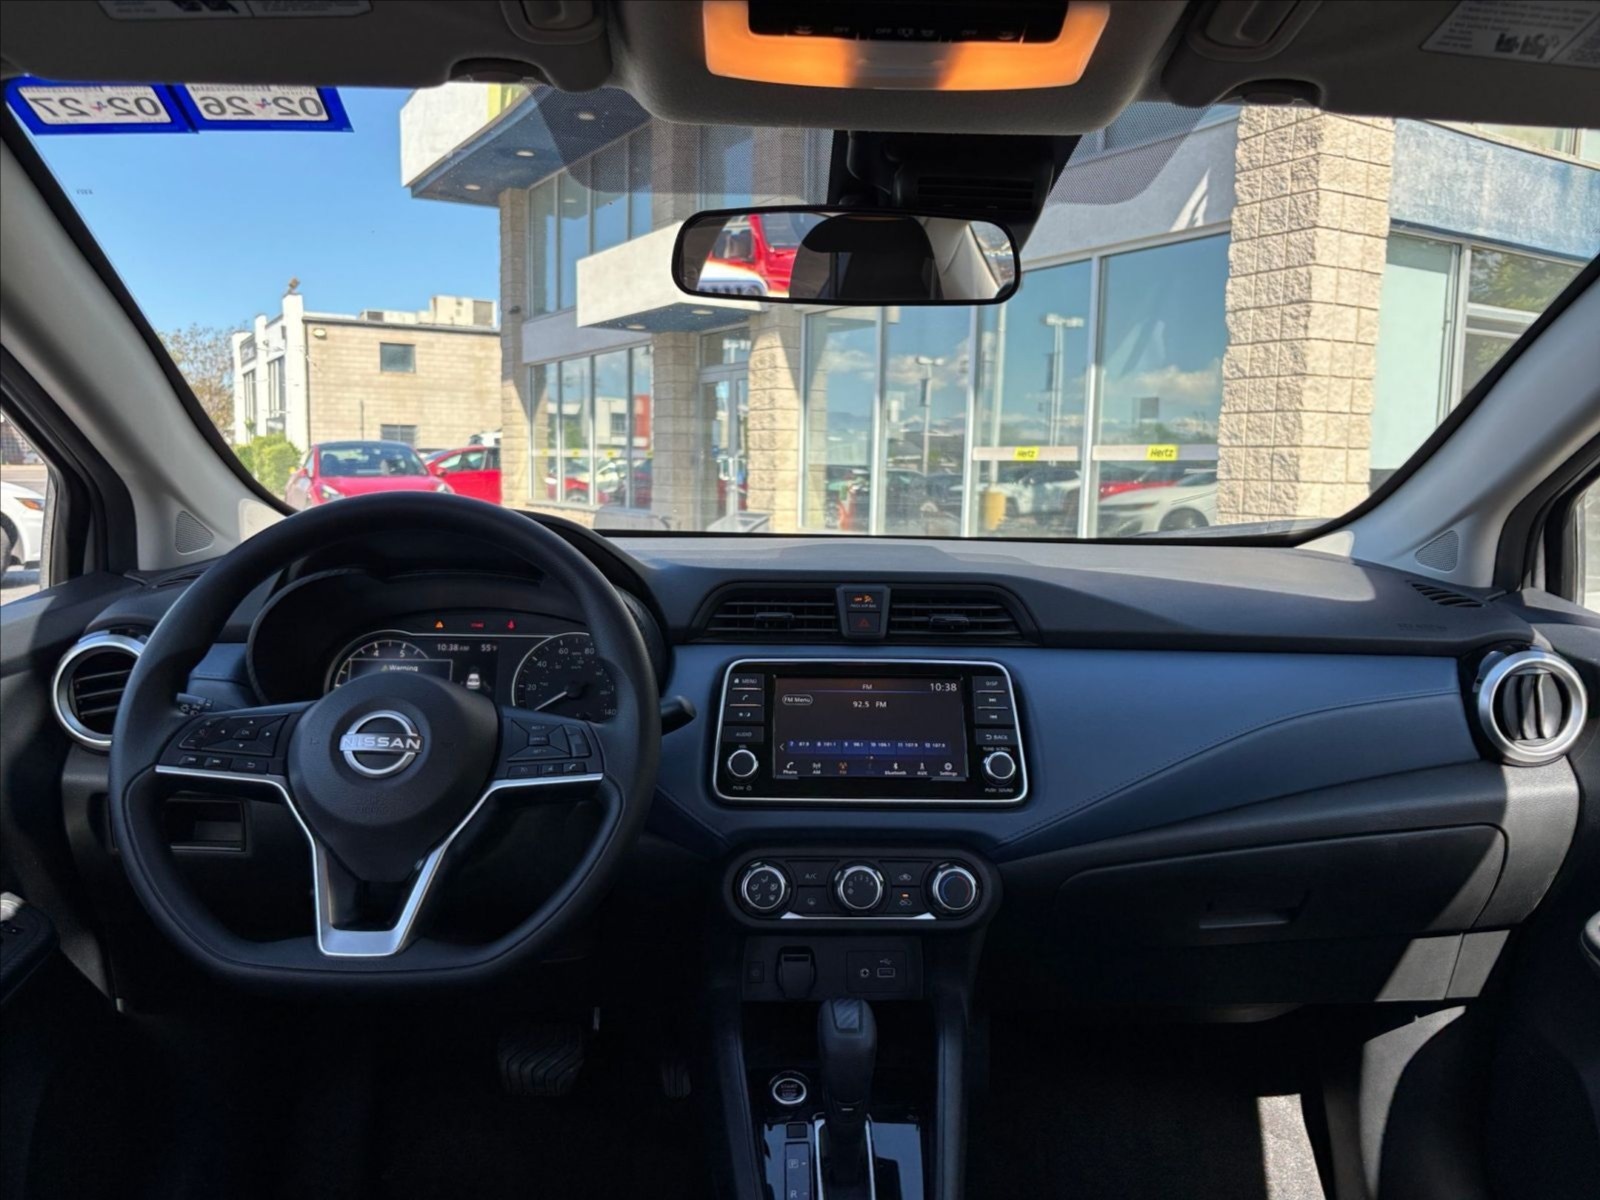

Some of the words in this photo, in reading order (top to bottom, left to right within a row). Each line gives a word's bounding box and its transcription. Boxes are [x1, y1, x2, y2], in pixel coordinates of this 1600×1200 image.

[1017, 449, 1036, 458] Hertz
[1150, 447, 1175, 458] Hertz
[437, 643, 459, 652] 10:38
[558, 647, 569, 655] 60
[584, 647, 595, 655] 80
[388, 664, 419, 672] Warning
[537, 660, 547, 668] 40
[930, 683, 957, 692] 10:38
[342, 736, 421, 750] NISSAN
[790, 1190, 798, 1199] R
